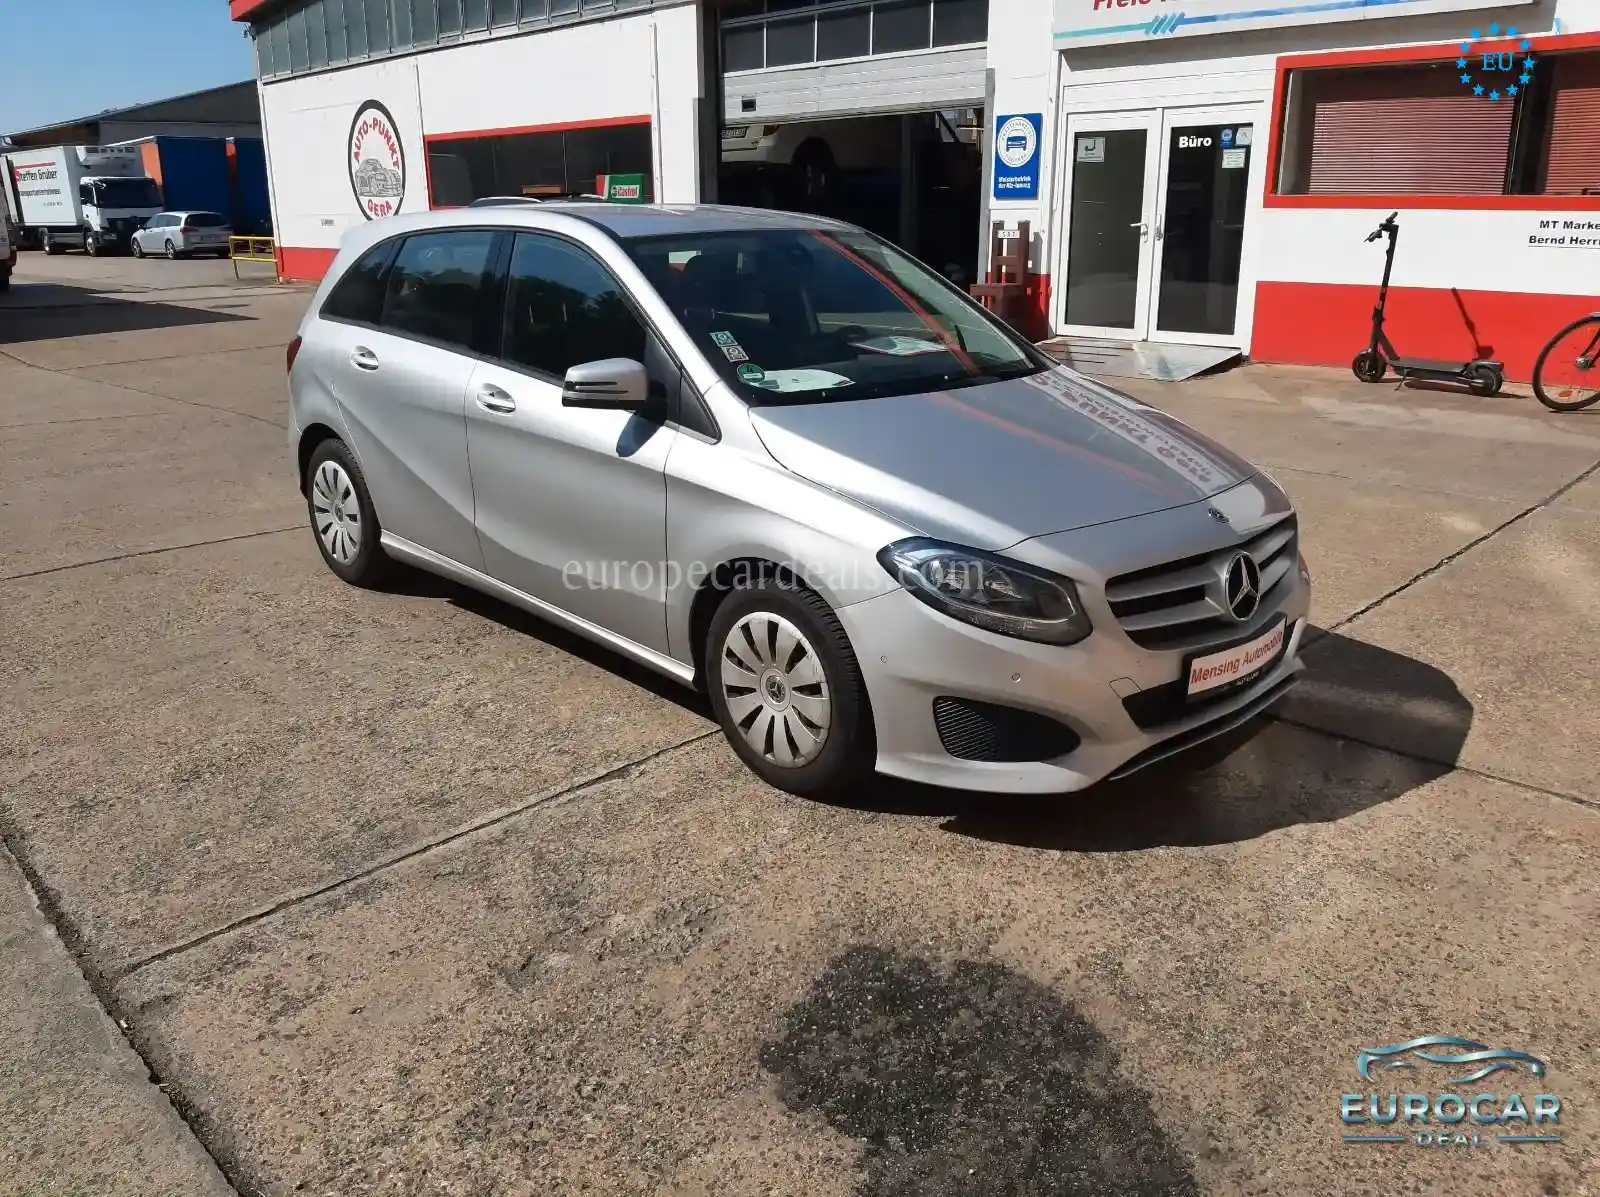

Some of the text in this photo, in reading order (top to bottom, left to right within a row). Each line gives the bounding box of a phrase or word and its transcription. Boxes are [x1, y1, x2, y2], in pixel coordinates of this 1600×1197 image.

[1179, 135, 1212, 148] Büro
[367, 199, 392, 217] GERA
[1540, 220, 1600, 230] MT Marke
[1528, 235, 1600, 246] Bernd Herr
[1190, 658, 1240, 685] Mensing
